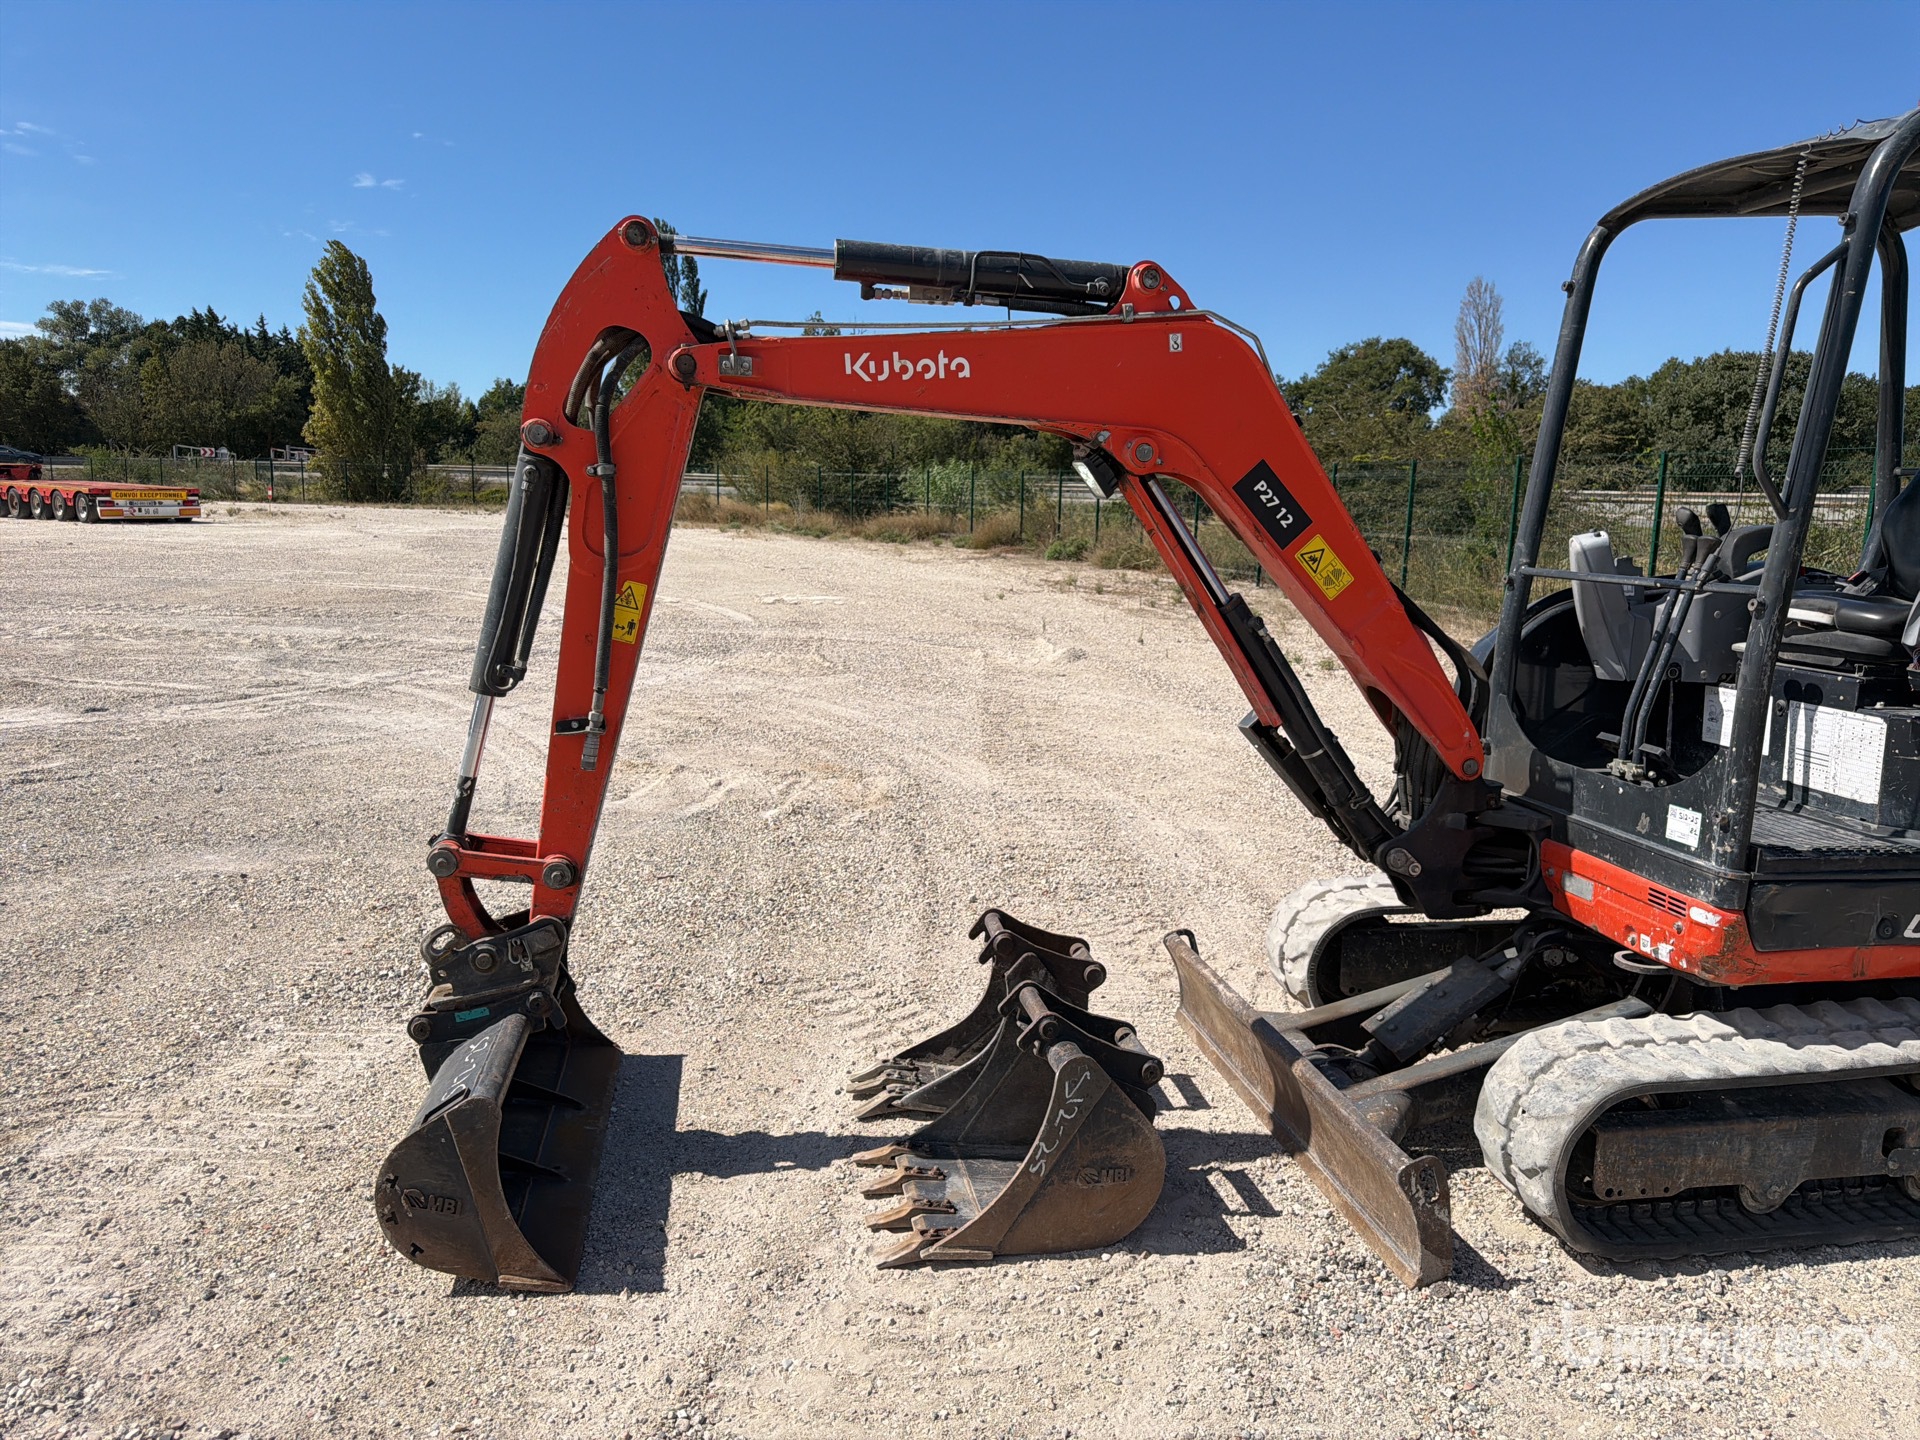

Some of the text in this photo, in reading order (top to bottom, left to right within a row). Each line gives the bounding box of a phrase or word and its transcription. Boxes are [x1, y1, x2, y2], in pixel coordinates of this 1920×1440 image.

[844, 349, 971, 382] Kubota
[1253, 479, 1294, 529] P27 12
